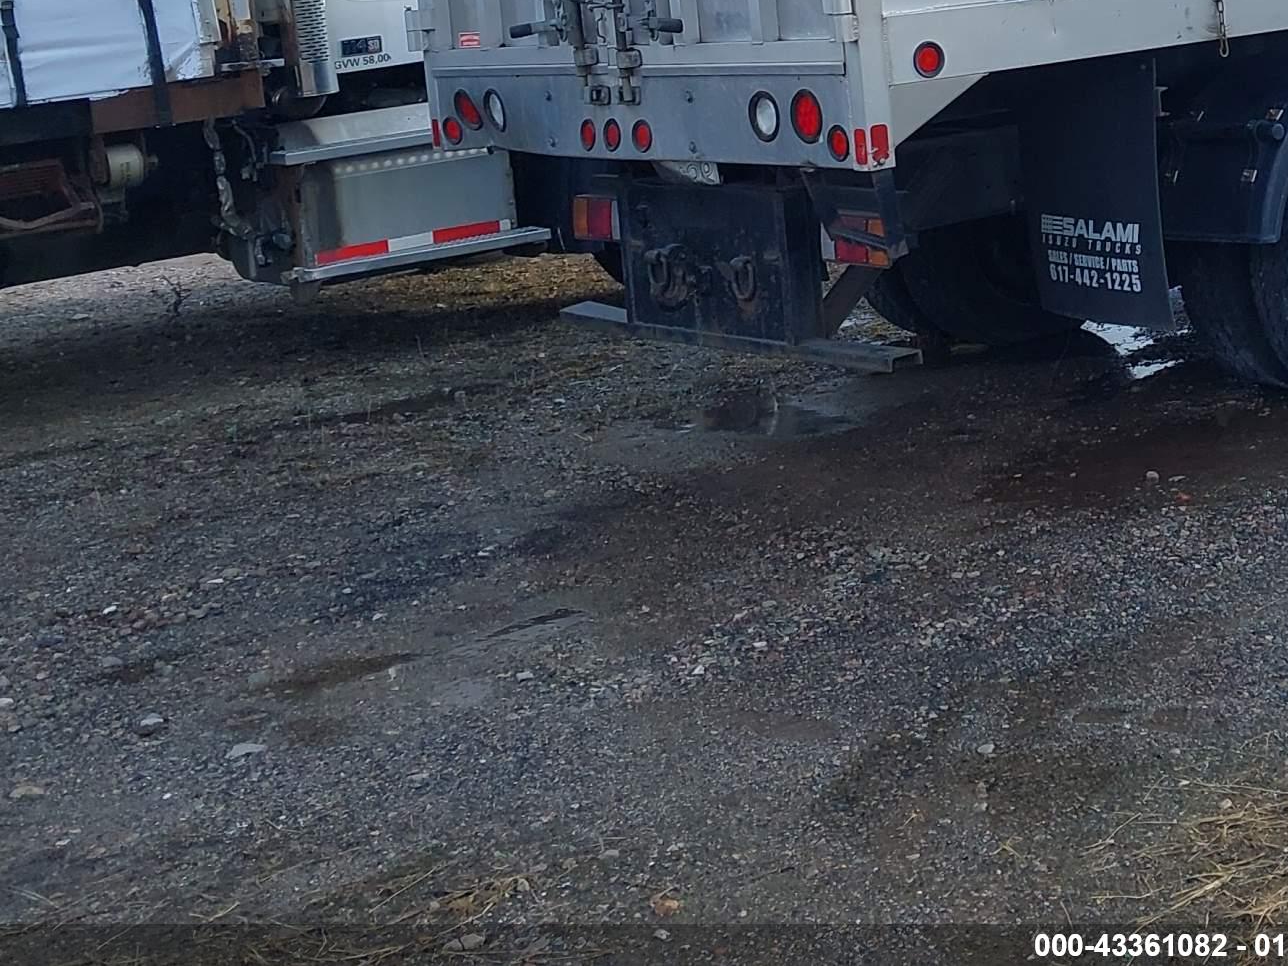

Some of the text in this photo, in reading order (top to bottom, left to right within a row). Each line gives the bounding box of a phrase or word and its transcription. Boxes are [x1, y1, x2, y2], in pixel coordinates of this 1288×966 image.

[334, 53, 392, 70] GVW 58,00
[1063, 217, 1140, 243] SALAMI
[1042, 234, 1142, 255] ISUZU TRUCKS
[1048, 249, 1069, 264] SALES
[1073, 253, 1105, 269] SERVICE
[1111, 257, 1139, 273] PARTS
